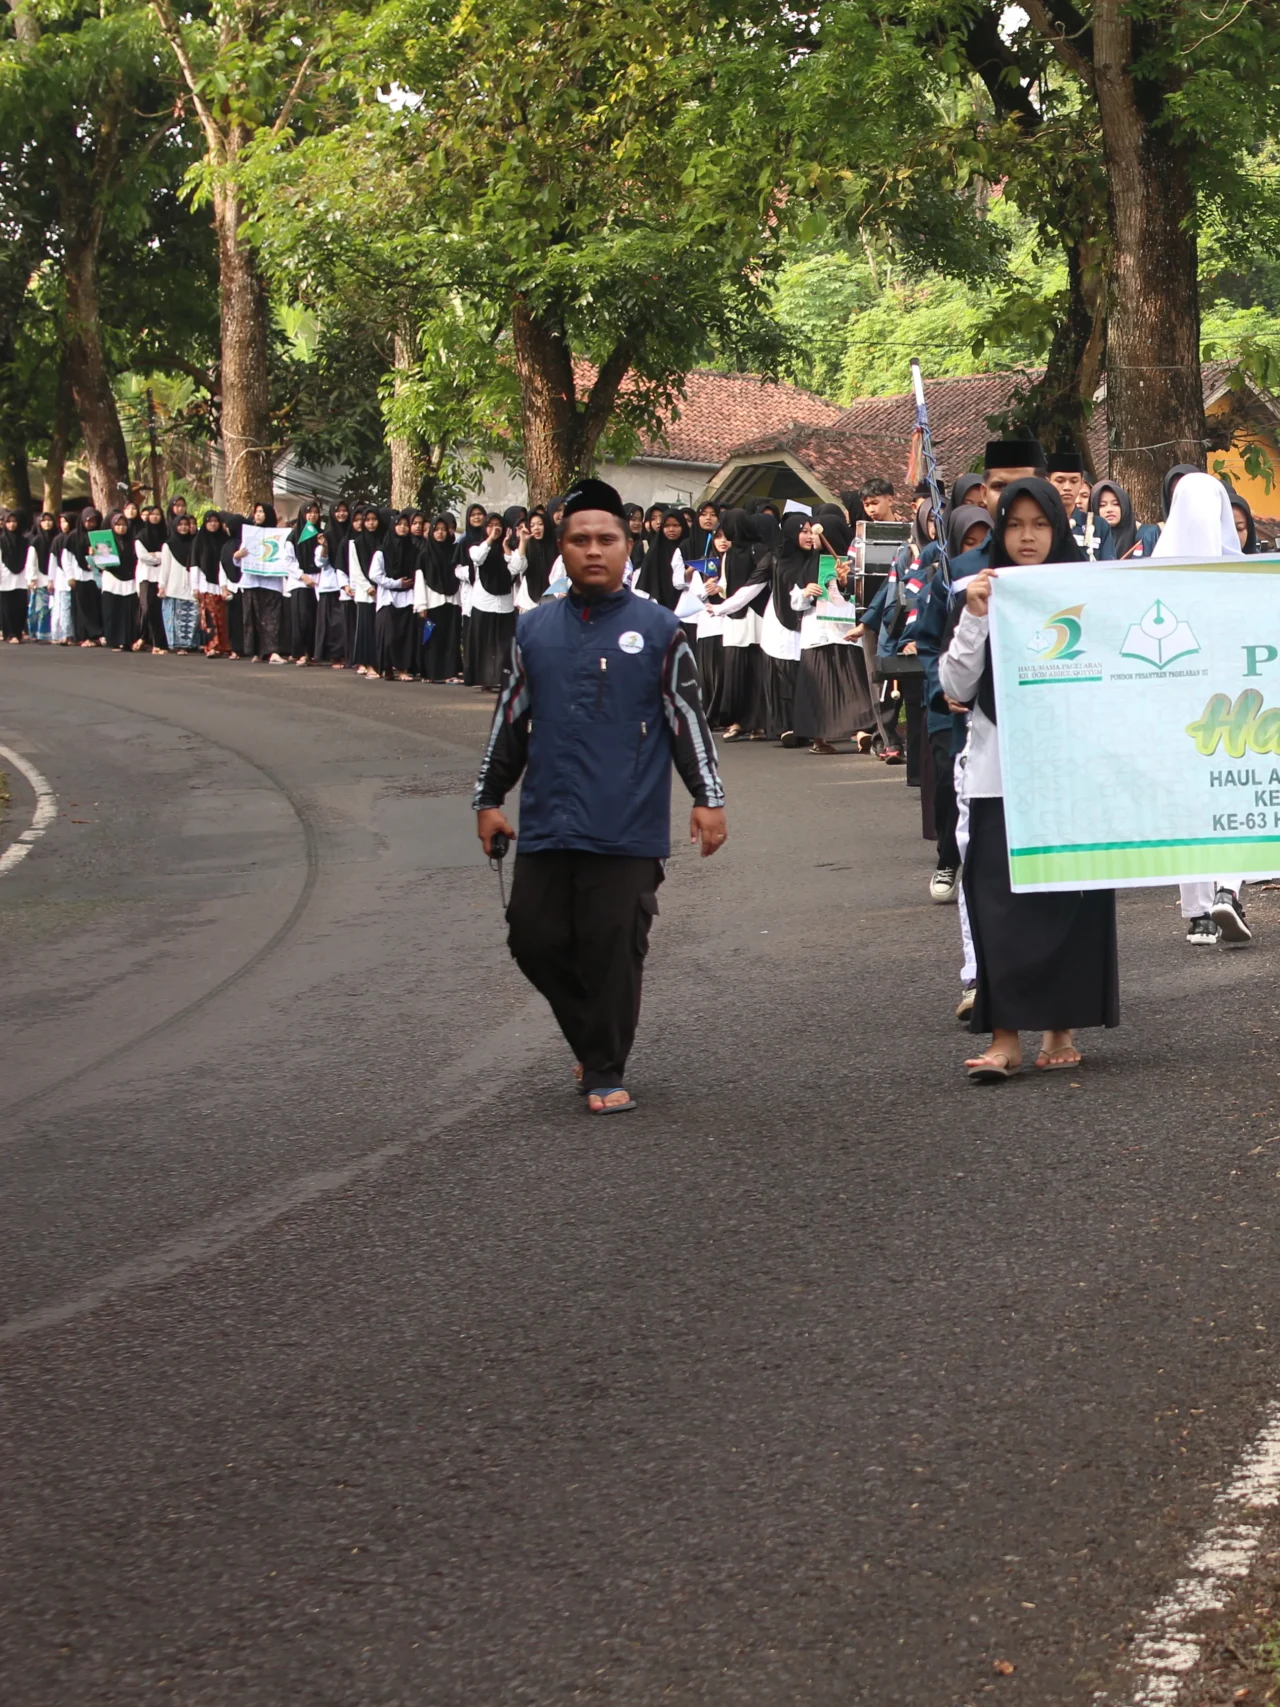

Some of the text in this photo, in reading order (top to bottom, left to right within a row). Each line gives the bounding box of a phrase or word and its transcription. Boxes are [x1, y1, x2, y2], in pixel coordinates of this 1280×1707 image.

[1018, 665, 1037, 673] HAUL
[1110, 673, 1133, 681] PONDOK
[1135, 671, 1167, 679] PESANTREN
[1168, 669, 1200, 677] PAGELARAN
[1209, 767, 1262, 787] HAUL
[1212, 811, 1267, 831] KE-63
